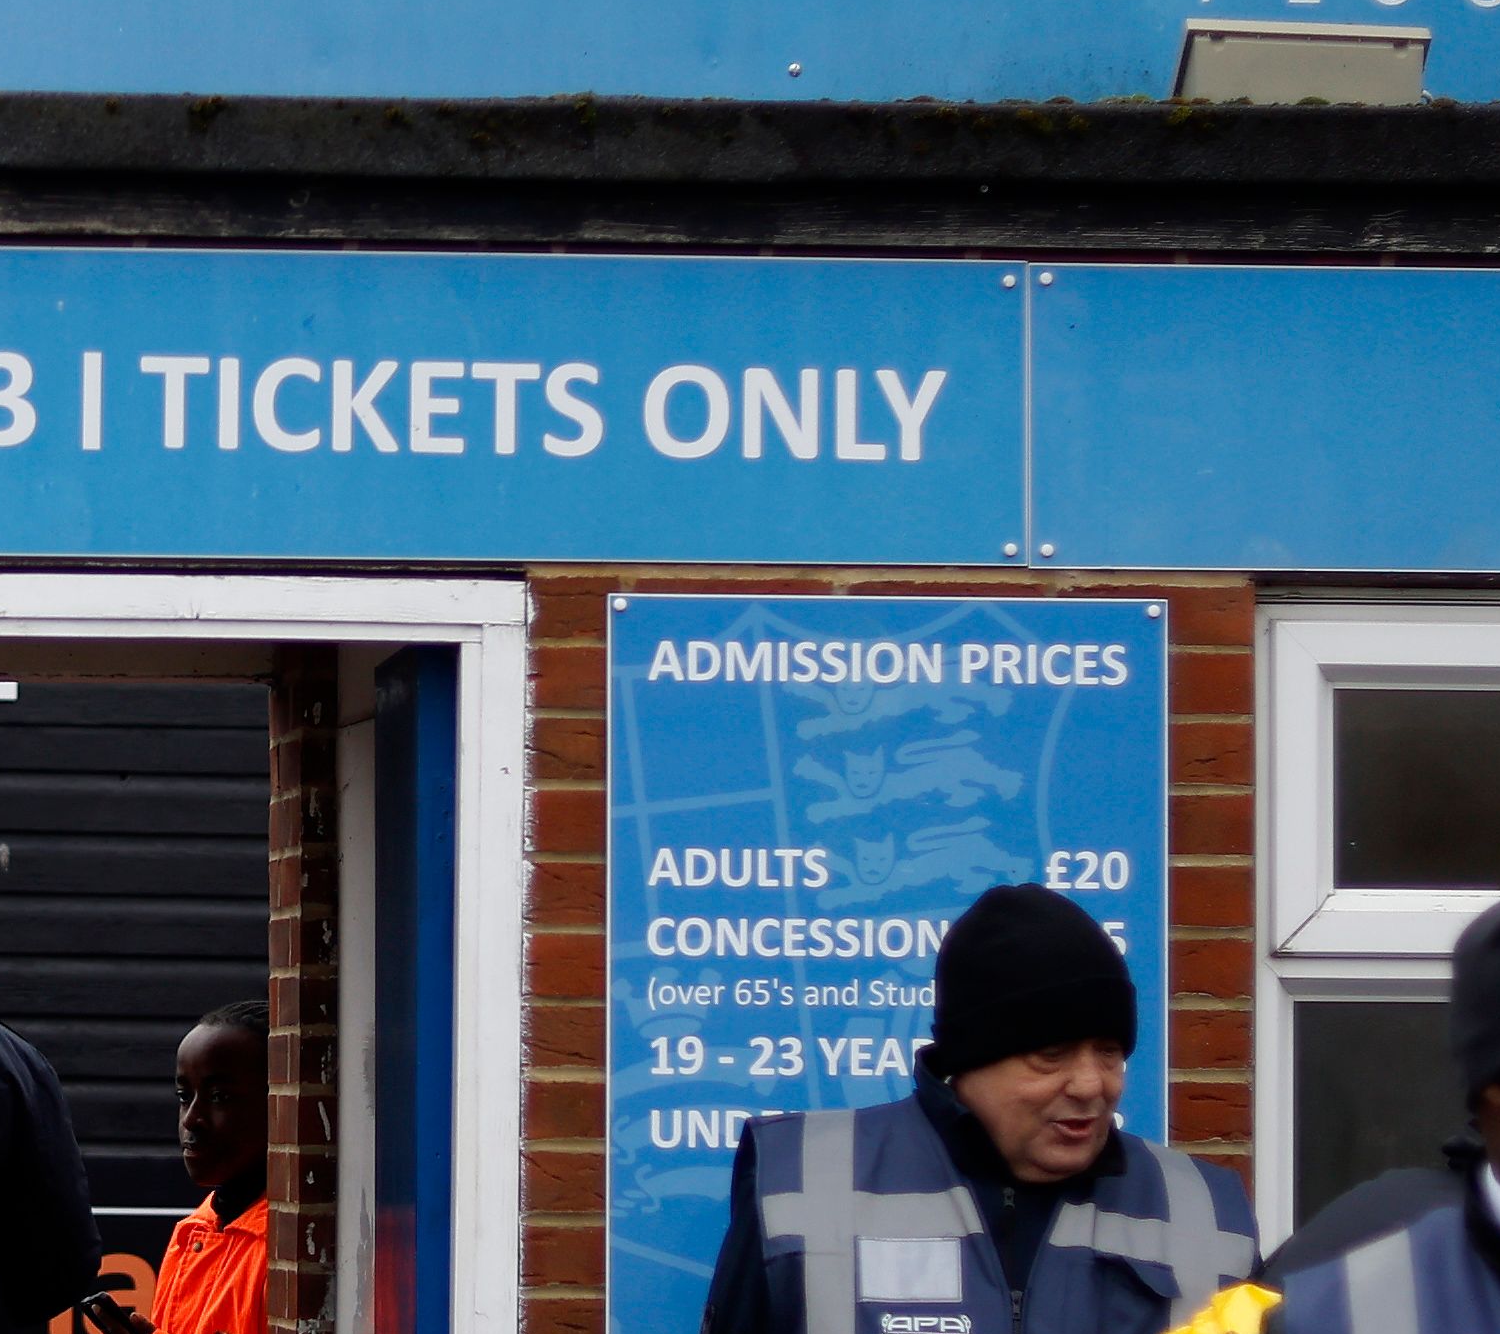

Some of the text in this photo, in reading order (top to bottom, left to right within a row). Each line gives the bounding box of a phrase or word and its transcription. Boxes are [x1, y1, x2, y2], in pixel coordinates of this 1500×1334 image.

[140, 355, 603, 458] TICKETS
[643, 364, 948, 462] ONLY
[649, 641, 1129, 686] ADMISSION PRICES
[648, 847, 1130, 890] ADULTS £20
[647, 917, 950, 958] CONCESSION
[648, 977, 936, 1010] (over 65's and Stud
[650, 1036, 805, 1076] 19 23
